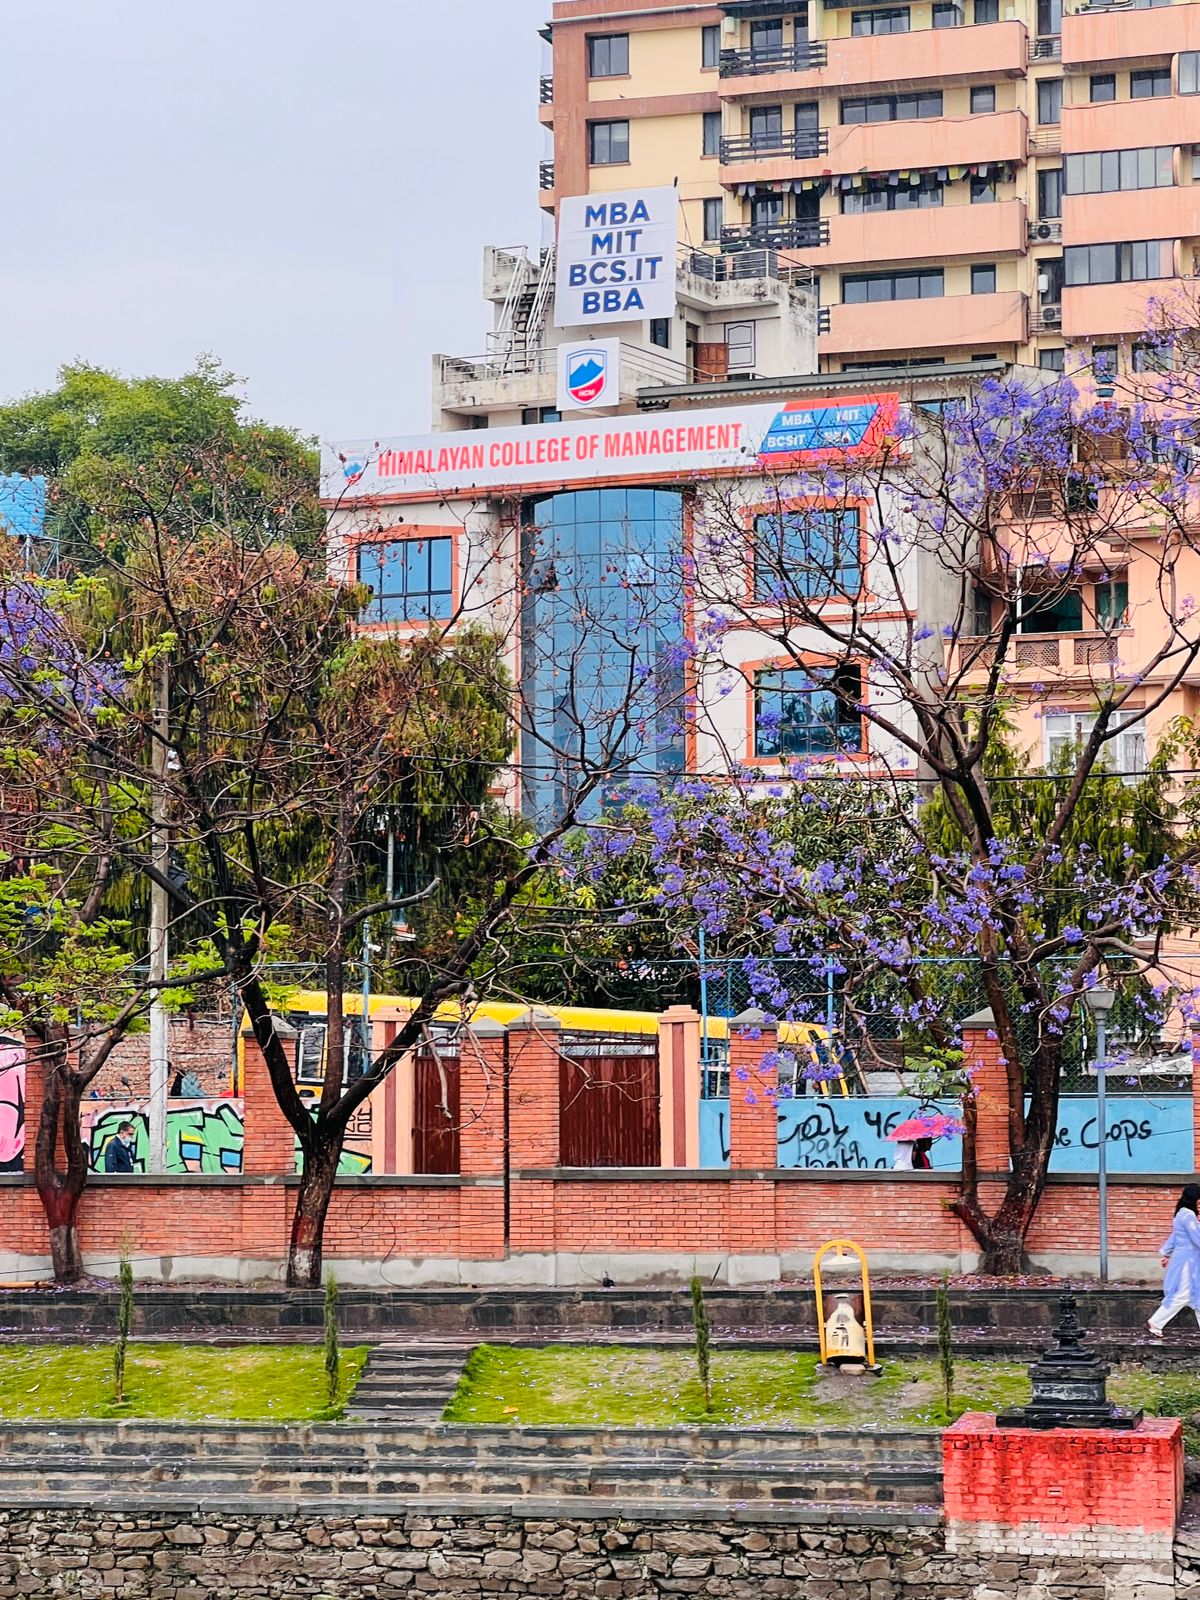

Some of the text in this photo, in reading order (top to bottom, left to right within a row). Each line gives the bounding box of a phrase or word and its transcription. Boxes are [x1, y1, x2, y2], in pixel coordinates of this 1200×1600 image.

[585, 199, 650, 228] MBA
[591, 229, 643, 256] MIT
[569, 256, 663, 287] BCS.IT
[582, 287, 645, 314] BBA
[781, 412, 813, 427] MBA
[378, 423, 742, 477] HIMALAYAN COLLEGE OF MANAGEMENT
[767, 433, 806, 448] BCSIT
[1080, 1117, 1152, 1157] Cops
